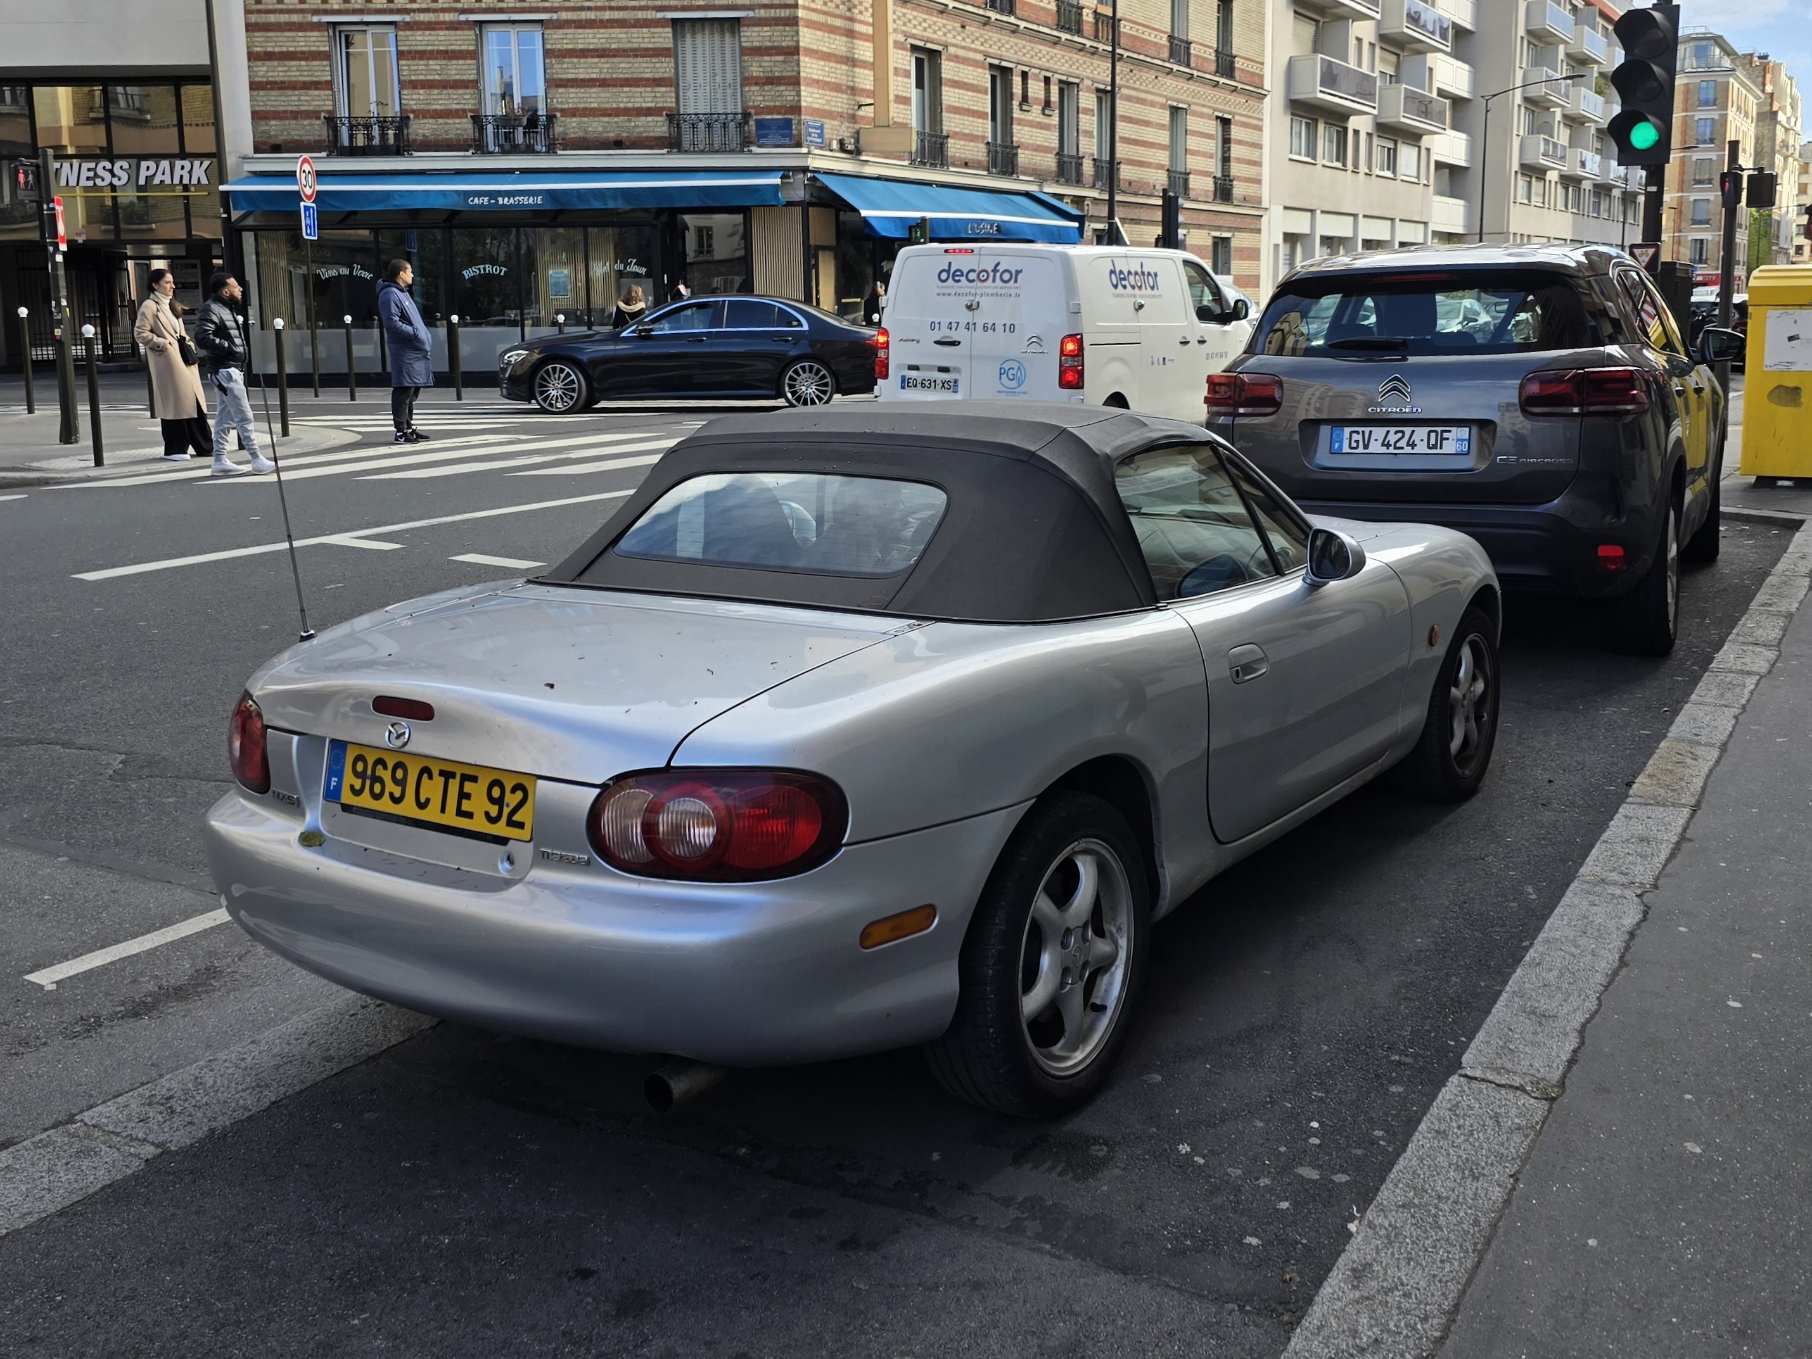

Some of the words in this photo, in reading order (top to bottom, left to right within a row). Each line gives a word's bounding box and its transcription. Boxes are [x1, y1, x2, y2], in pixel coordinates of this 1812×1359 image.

[53, 160, 130, 187] NESS
[138, 160, 212, 186] PARK
[302, 169, 313, 190] 30
[497, 195, 543, 205] BRASSERIE
[316, 268, 339, 280] Vins
[340, 267, 350, 276] au
[461, 263, 508, 280] BISTROT
[614, 259, 624, 271] du
[626, 258, 648, 275] Jour
[937, 261, 1024, 284] decofor
[1109, 258, 1160, 292] decofor
[930, 321, 942, 332] 01
[946, 321, 960, 332] 47
[964, 322, 977, 332] 41
[982, 322, 996, 333] 64
[1002, 323, 1016, 334] 10
[1348, 429, 1452, 450] GV-424-QF
[1456, 440, 1468, 451] 60
[330, 777, 339, 790] F
[349, 754, 409, 805] 969
[414, 765, 479, 820] CTE
[484, 778, 529, 831] 92
